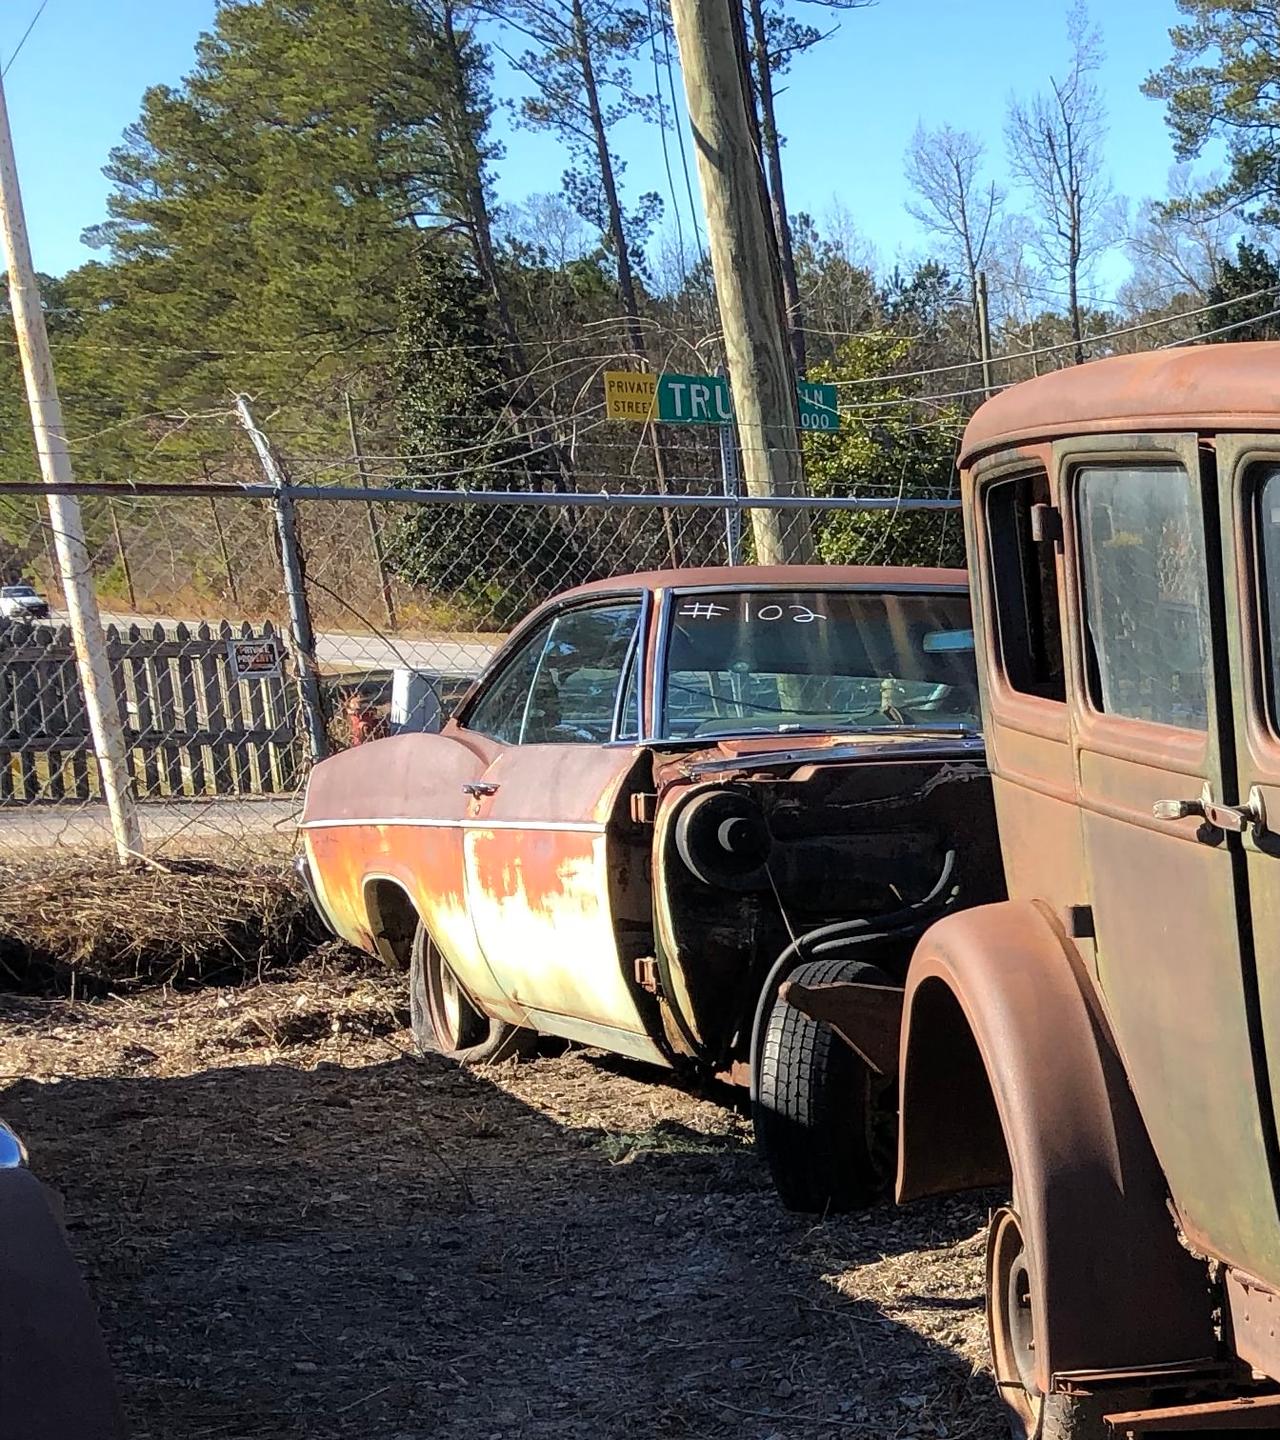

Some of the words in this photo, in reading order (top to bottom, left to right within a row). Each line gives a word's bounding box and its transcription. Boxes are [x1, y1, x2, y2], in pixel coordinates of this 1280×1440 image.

[608, 380, 655, 394] PRIVATE
[668, 383, 734, 420] TRU
[679, 602, 827, 623] #102
